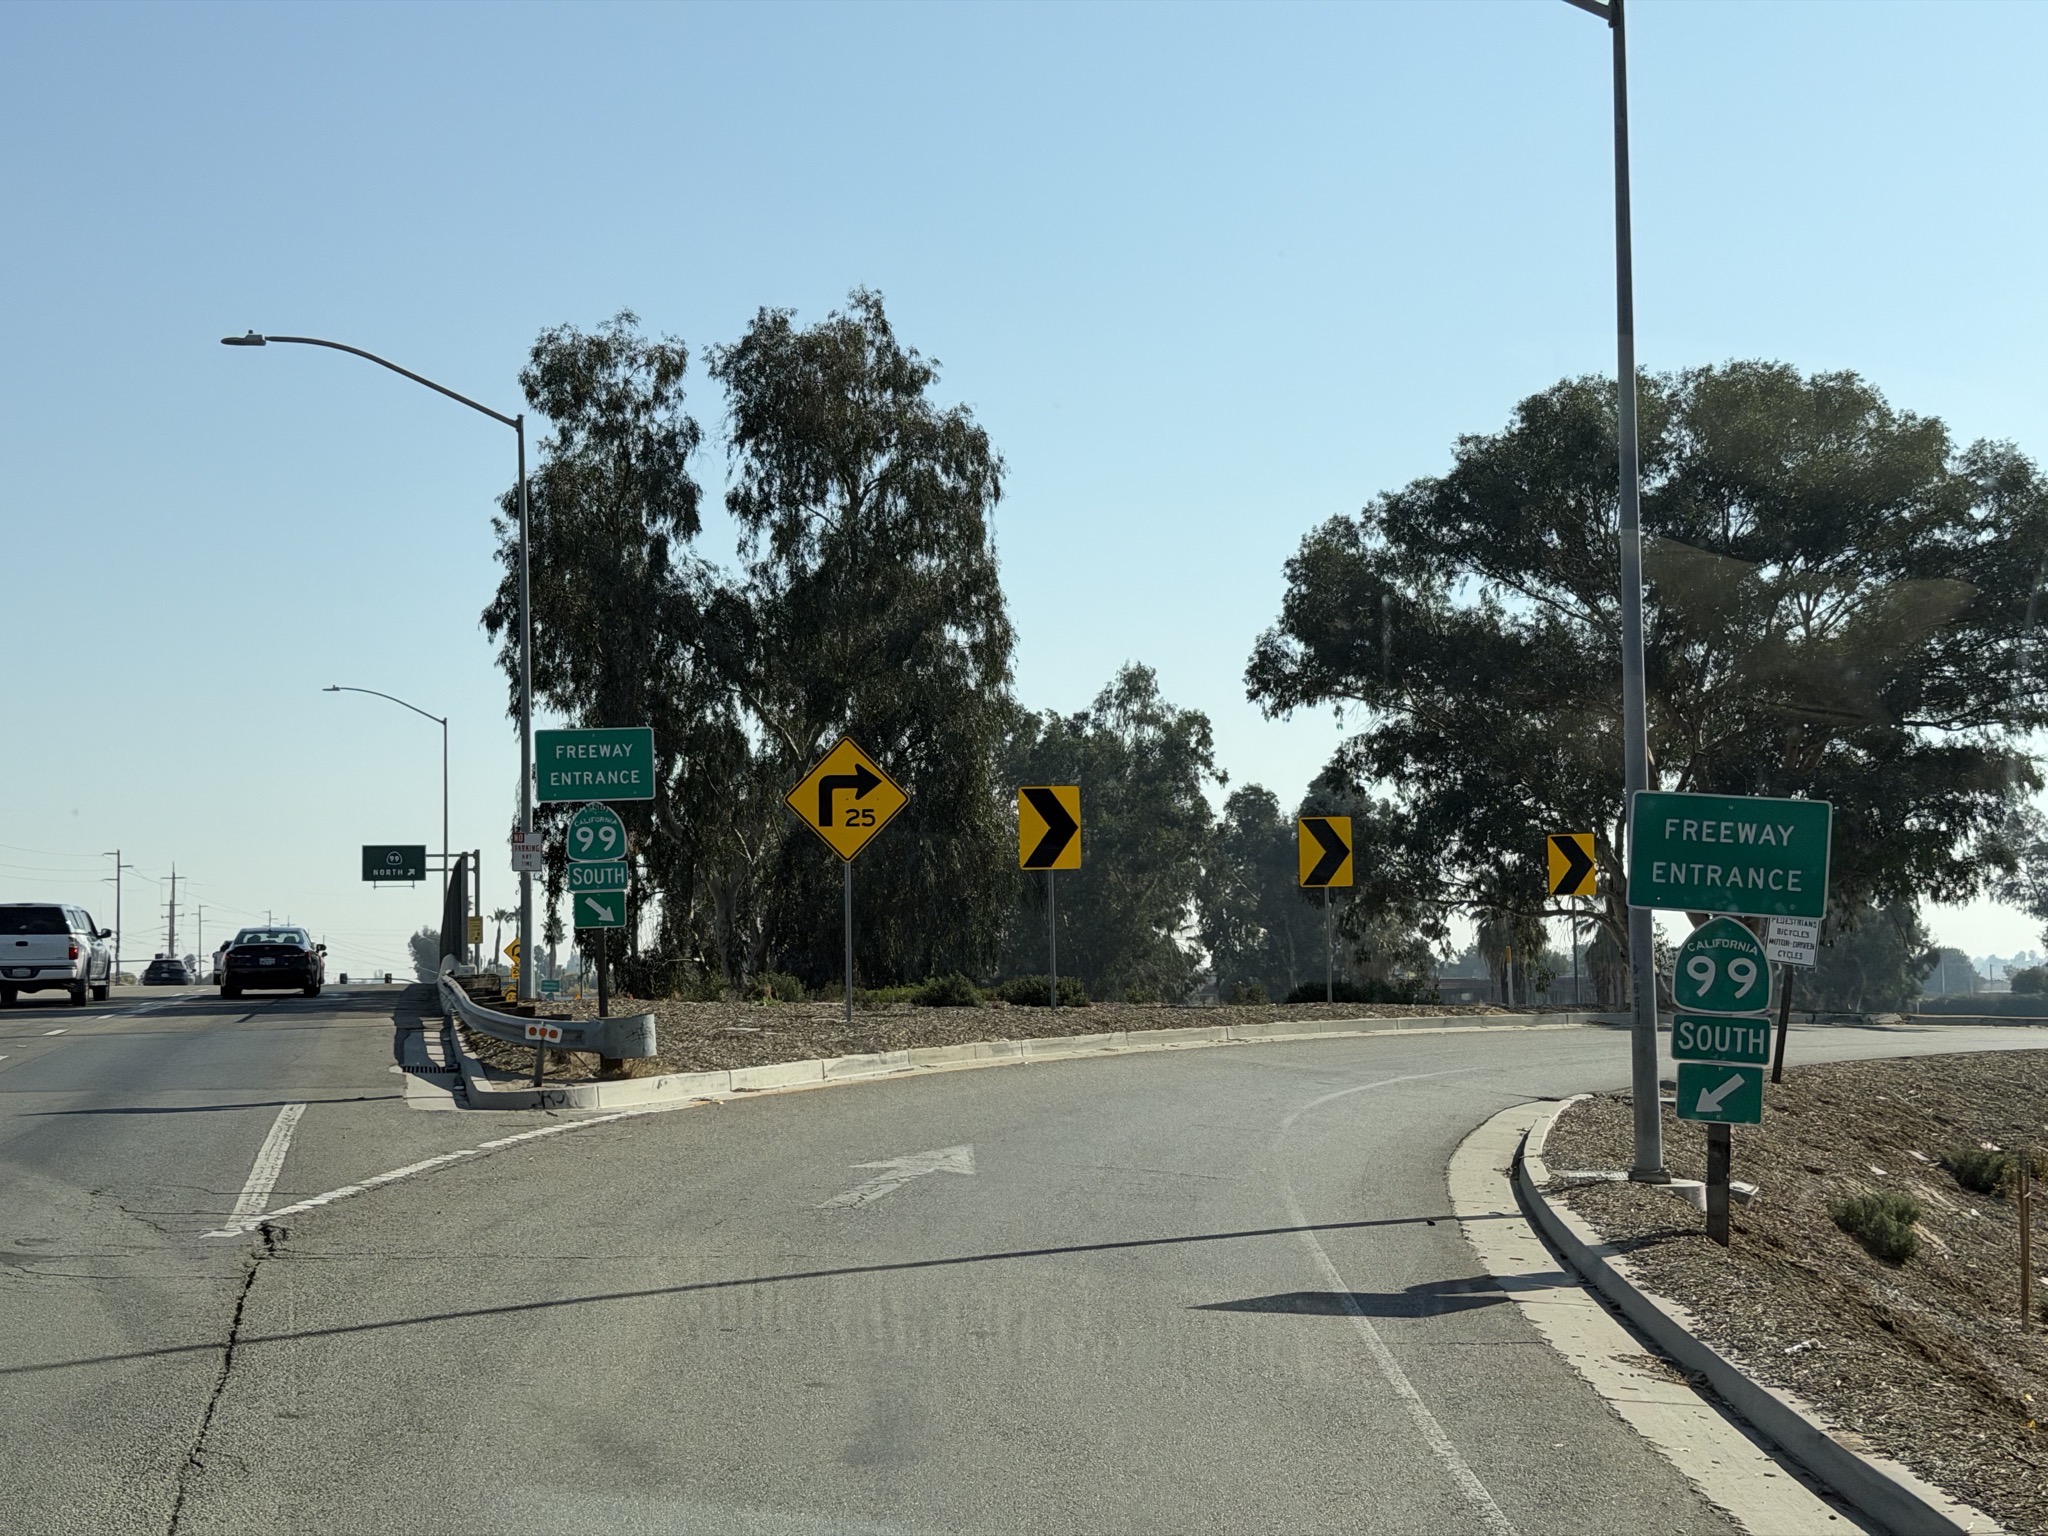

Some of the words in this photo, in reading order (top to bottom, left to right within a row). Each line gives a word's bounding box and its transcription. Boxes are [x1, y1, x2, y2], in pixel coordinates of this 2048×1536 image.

[556, 744, 633, 759] FREEWAY
[550, 770, 640, 786] ENTRANCE
[574, 816, 618, 827] CALIFORNIA
[845, 808, 876, 827] 25
[576, 826, 617, 852] 99
[1664, 818, 1795, 847] FREEWAY
[514, 844, 540, 852] PARKING
[389, 855, 400, 863] 99
[373, 868, 404, 876] NORTH
[572, 867, 625, 885] SOUTH
[1652, 861, 1802, 892] ENTRANCE
[1776, 928, 1810, 939] BICYCLES
[1687, 938, 1758, 956] CALIFORNIA
[1768, 937, 1815, 951] MOTOR-DRIVEN
[1777, 950, 1804, 960] CYCLES
[1687, 955, 1758, 1000] 99
[1677, 1021, 1765, 1055] SOUTH
